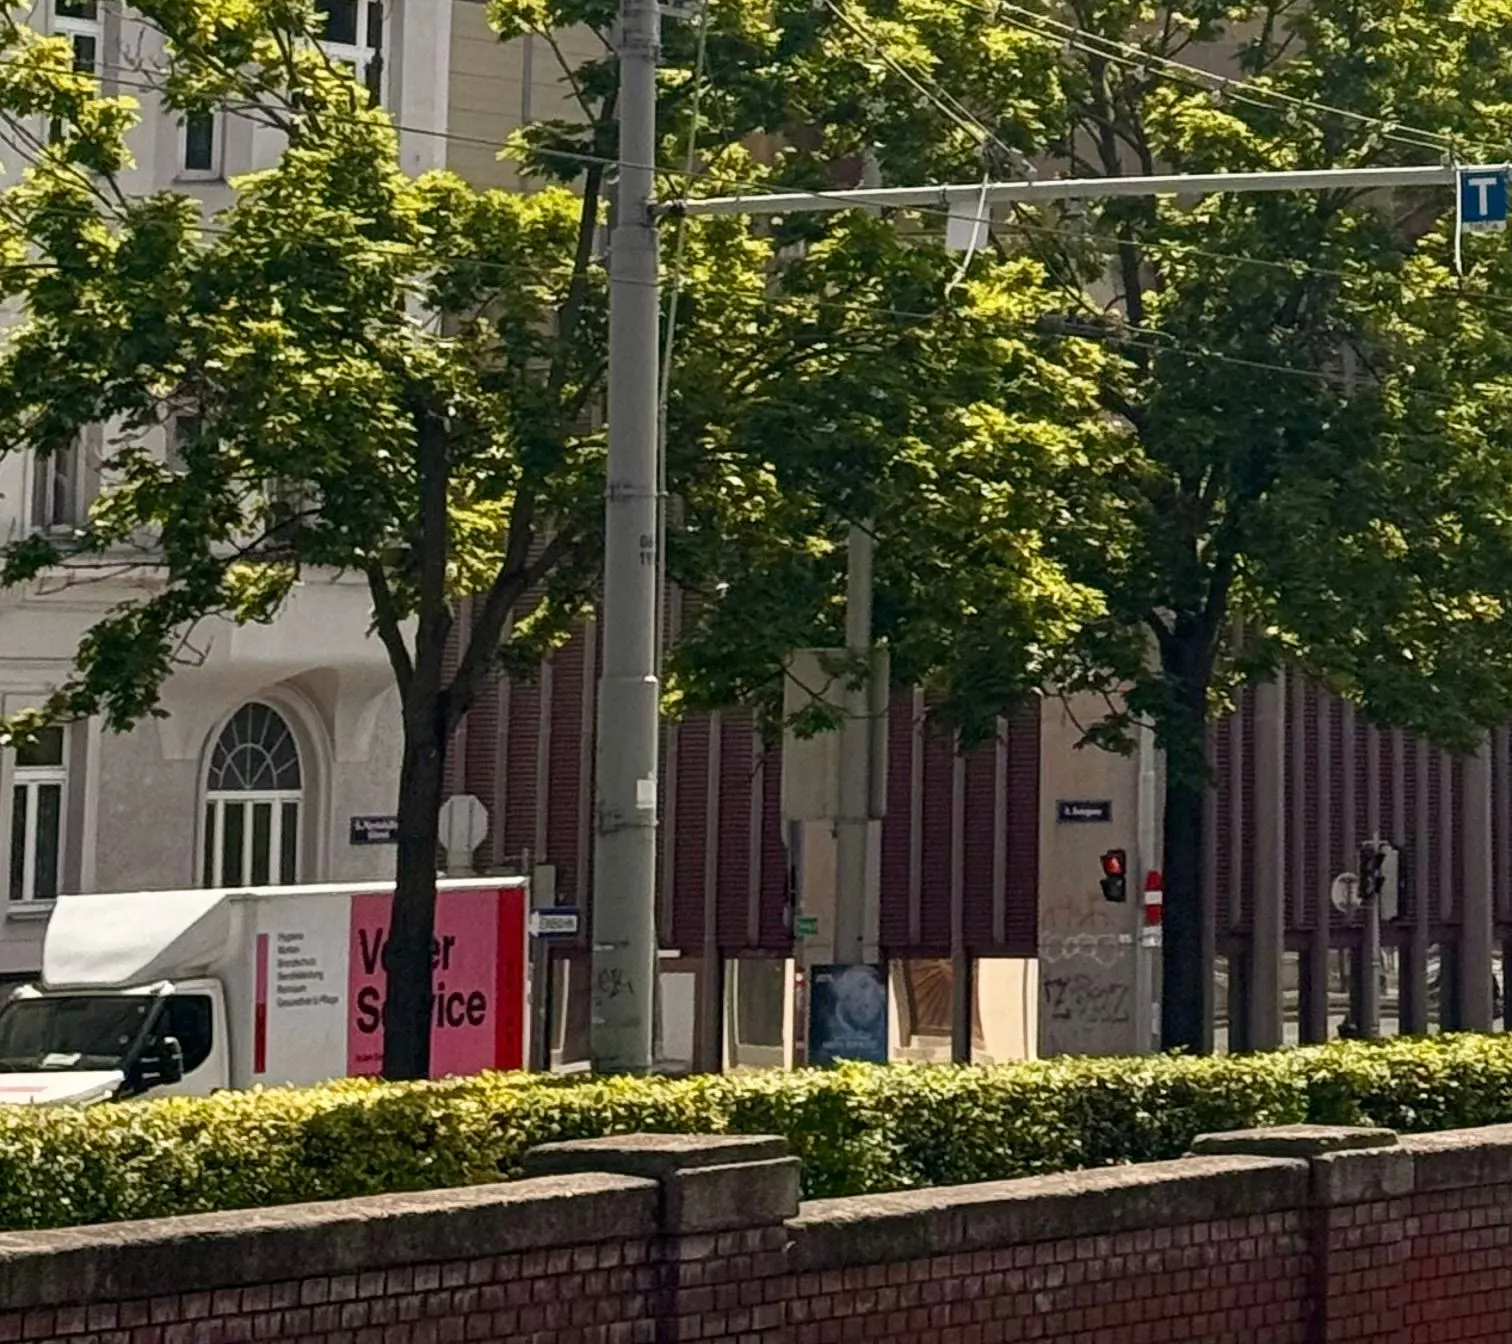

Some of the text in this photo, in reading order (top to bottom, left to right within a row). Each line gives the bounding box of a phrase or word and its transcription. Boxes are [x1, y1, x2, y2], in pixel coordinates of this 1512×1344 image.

[1468, 177, 1497, 216] T
[358, 928, 456, 975] Ver
[357, 981, 487, 1034] Sice
